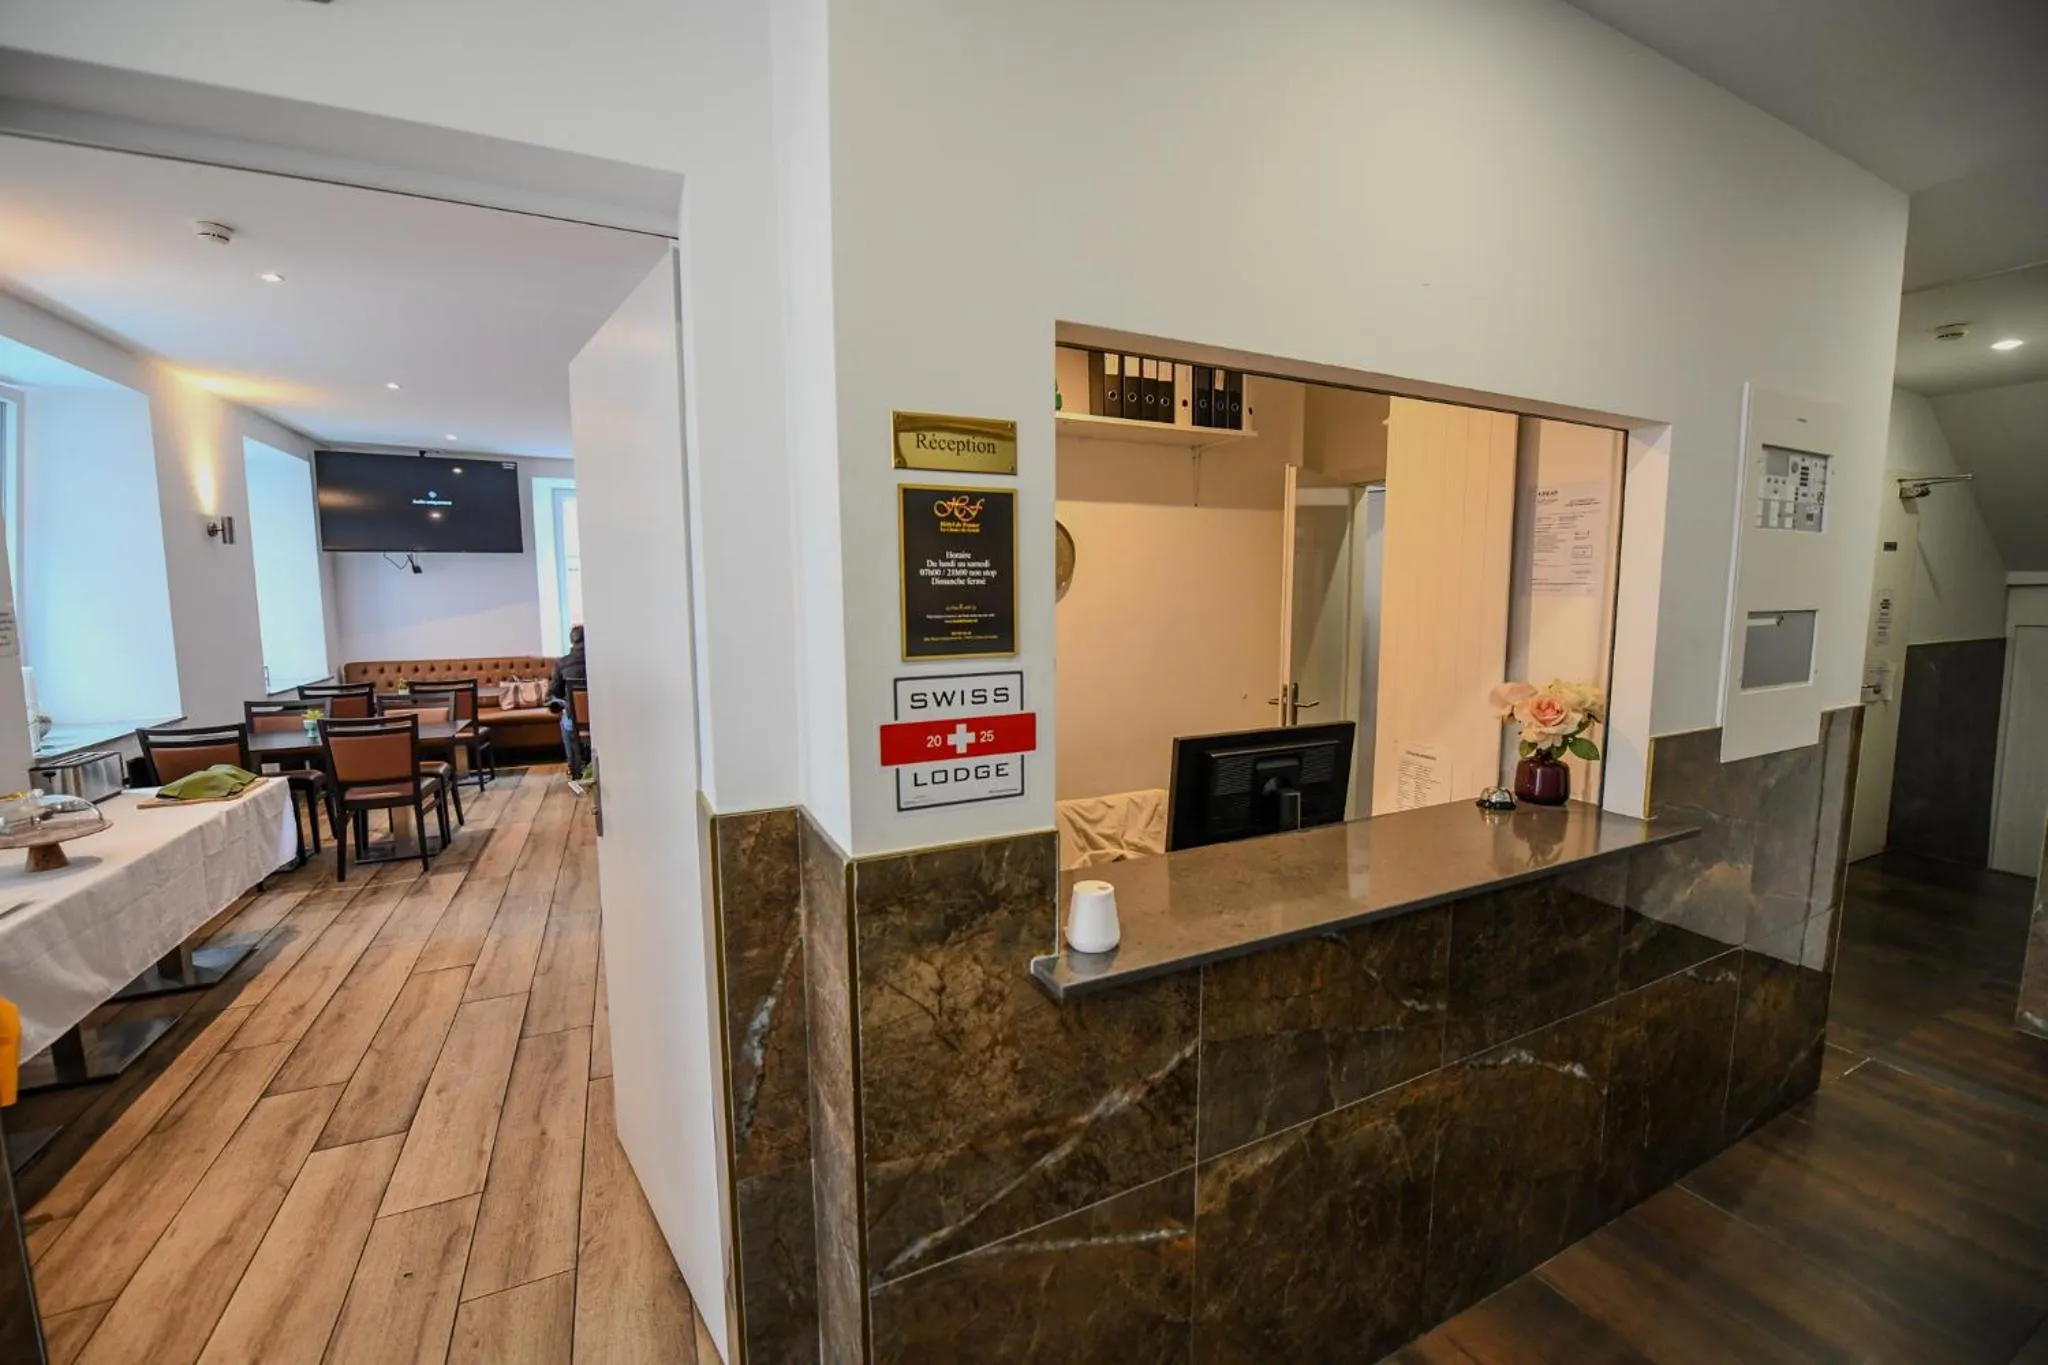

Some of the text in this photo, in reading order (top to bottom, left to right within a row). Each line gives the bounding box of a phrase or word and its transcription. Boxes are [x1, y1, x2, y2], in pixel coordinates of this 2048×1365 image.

[916, 433, 996, 456] Réception
[938, 559, 956, 568] lundi
[967, 560, 990, 568] samedi
[983, 570, 997, 578] stop
[910, 687, 1010, 710] SWISS
[926, 730, 995, 748] 20 25
[914, 763, 1009, 787] LODGE
